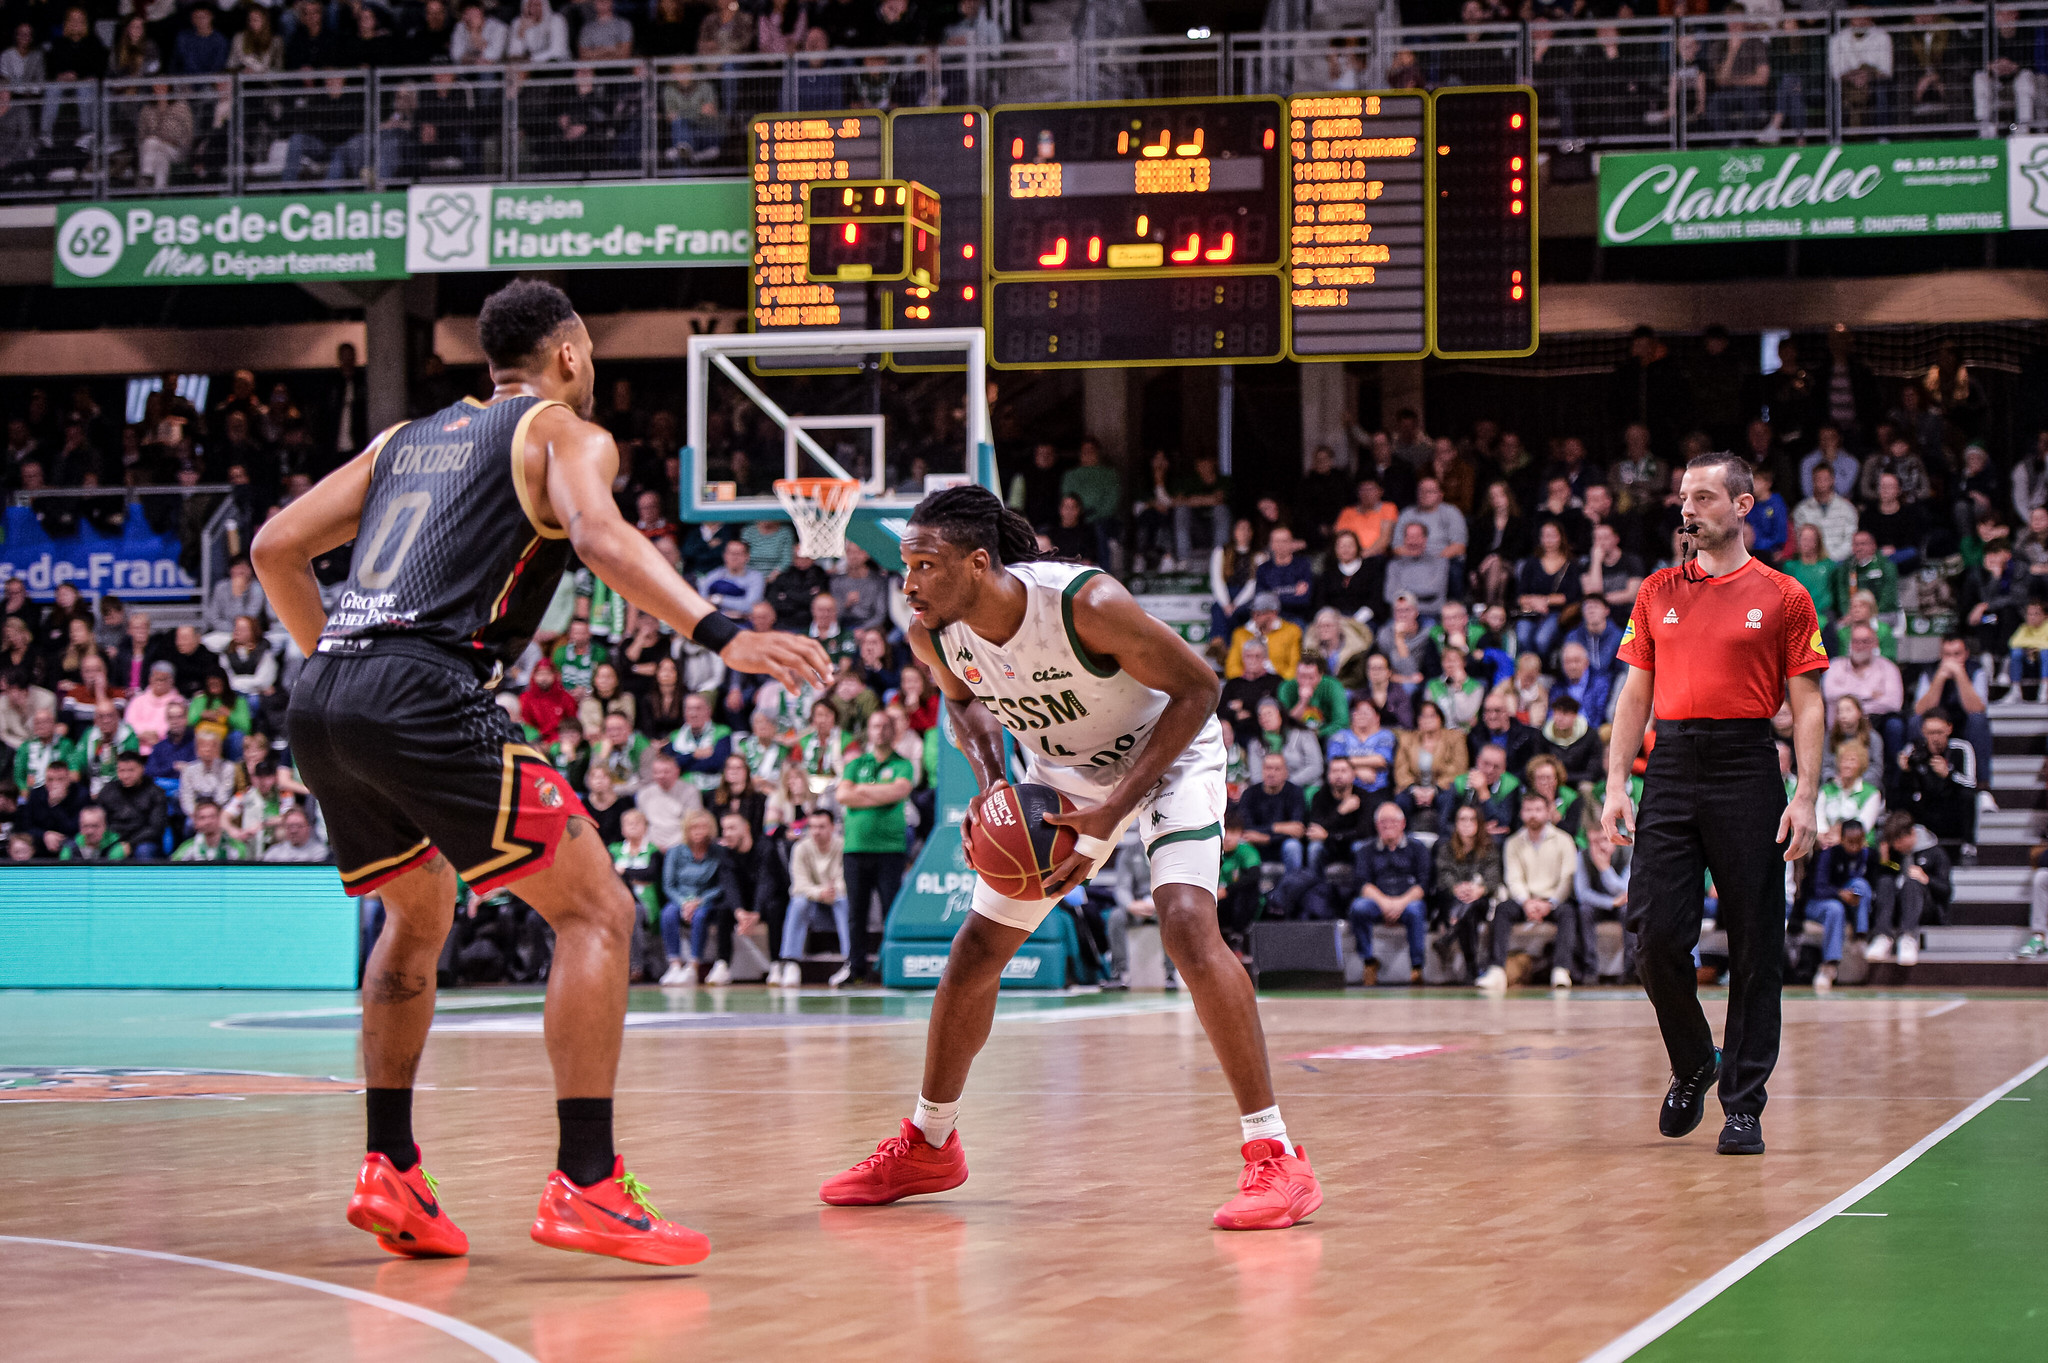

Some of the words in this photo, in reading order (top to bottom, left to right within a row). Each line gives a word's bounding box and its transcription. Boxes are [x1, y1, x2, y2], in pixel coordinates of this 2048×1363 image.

[495, 195, 584, 225] Région
[1604, 148, 1884, 243] Claudelec
[68, 226, 111, 258] 62
[212, 249, 376, 281] Département
[391, 441, 474, 475] OKOBO
[357, 490, 432, 589] 0
[340, 591, 398, 610] GROUPE
[1745, 621, 1761, 629] FFBB
[994, 789, 1017, 826] EGACY
